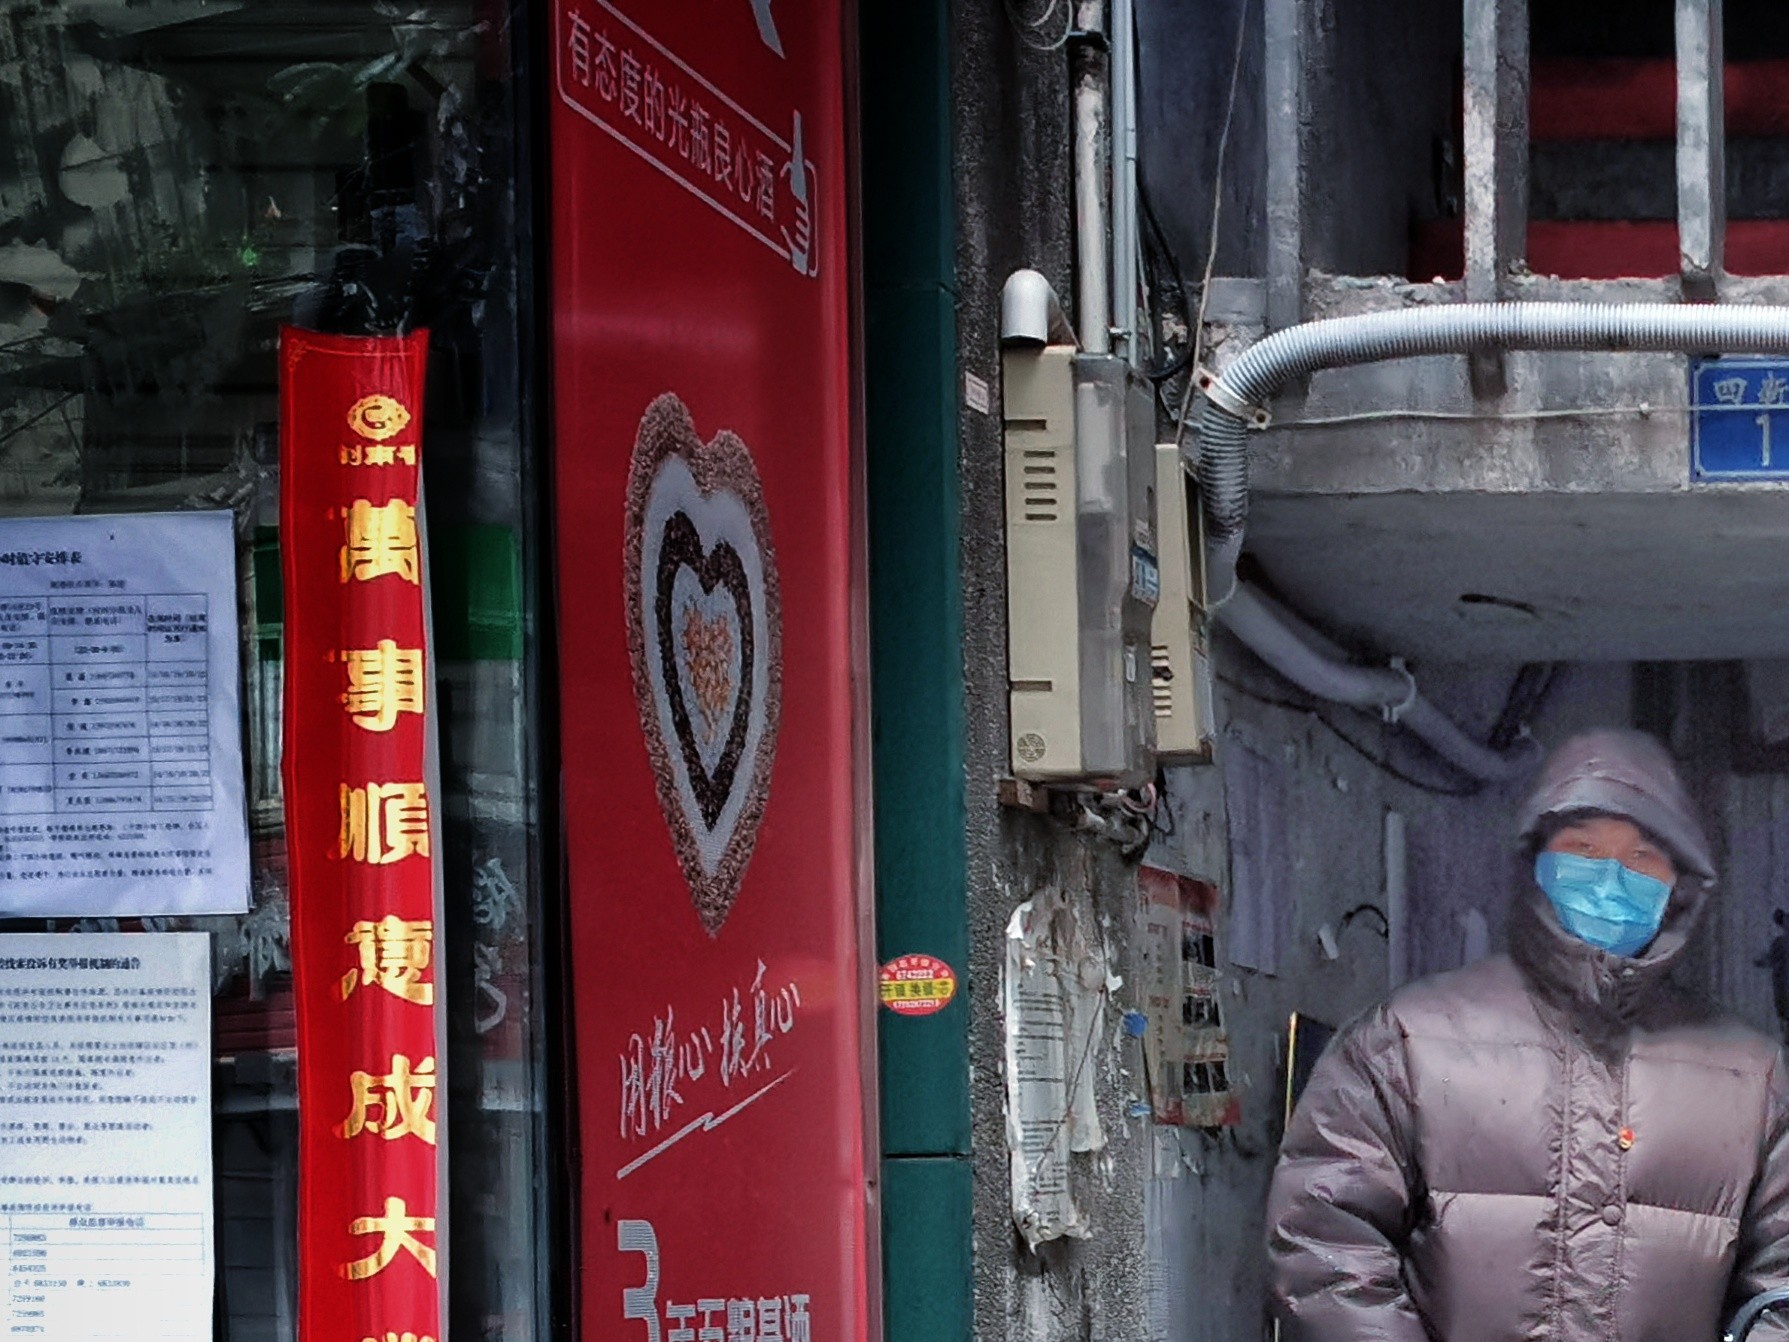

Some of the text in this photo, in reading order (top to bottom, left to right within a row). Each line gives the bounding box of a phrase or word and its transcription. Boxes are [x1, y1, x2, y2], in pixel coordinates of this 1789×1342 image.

[567, 8, 775, 223] 有态度的光瓶良心酒
